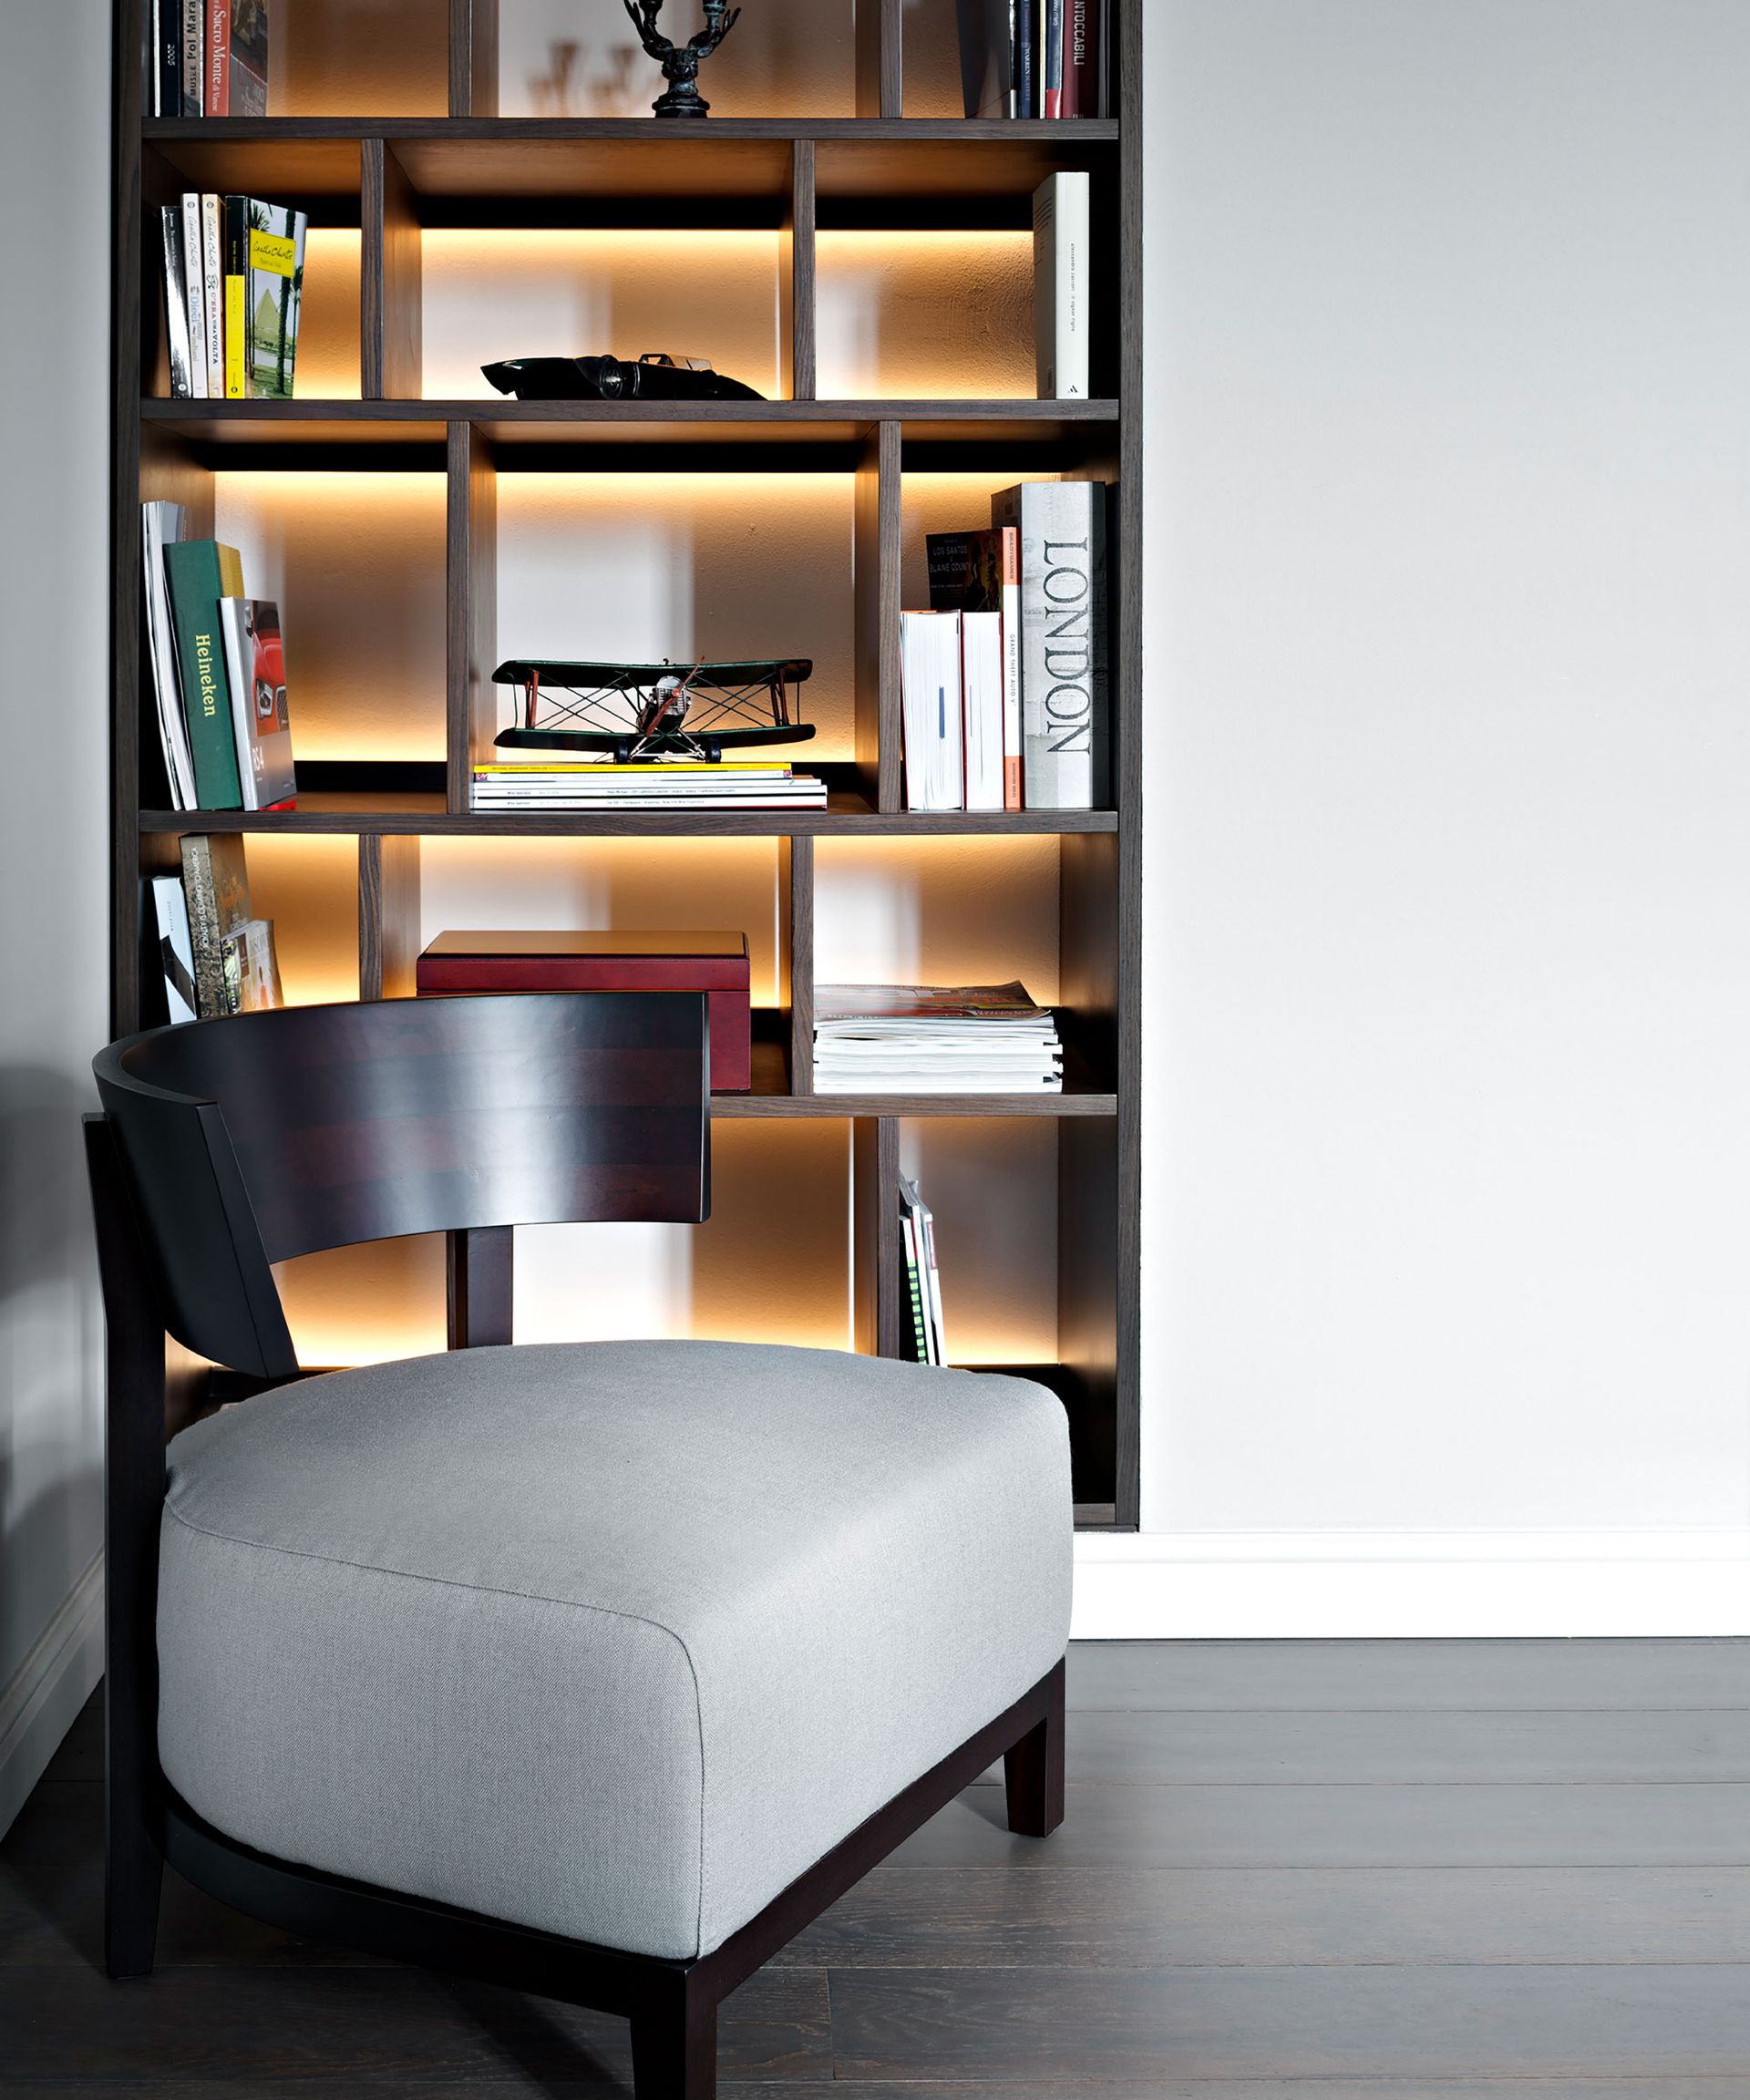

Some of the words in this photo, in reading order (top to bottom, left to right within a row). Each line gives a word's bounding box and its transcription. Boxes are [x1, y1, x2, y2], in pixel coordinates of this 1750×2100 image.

[212, 10, 227, 43] Sacro
[1074, 1, 1085, 65] NTOCCABILI
[167, 44, 175, 66] 2005
[212, 46, 227, 84] Monte
[190, 296, 201, 323] Dieci
[932, 547, 945, 556] LOS
[946, 545, 968, 555] SANTOS
[929, 563, 950, 572] BLAINE
[1043, 537, 1090, 755] LONDON
[196, 634, 217, 716] Heineken
[190, 846, 201, 875] AMERICA
[194, 874, 202, 885] TO
[195, 885, 206, 914] COMING
